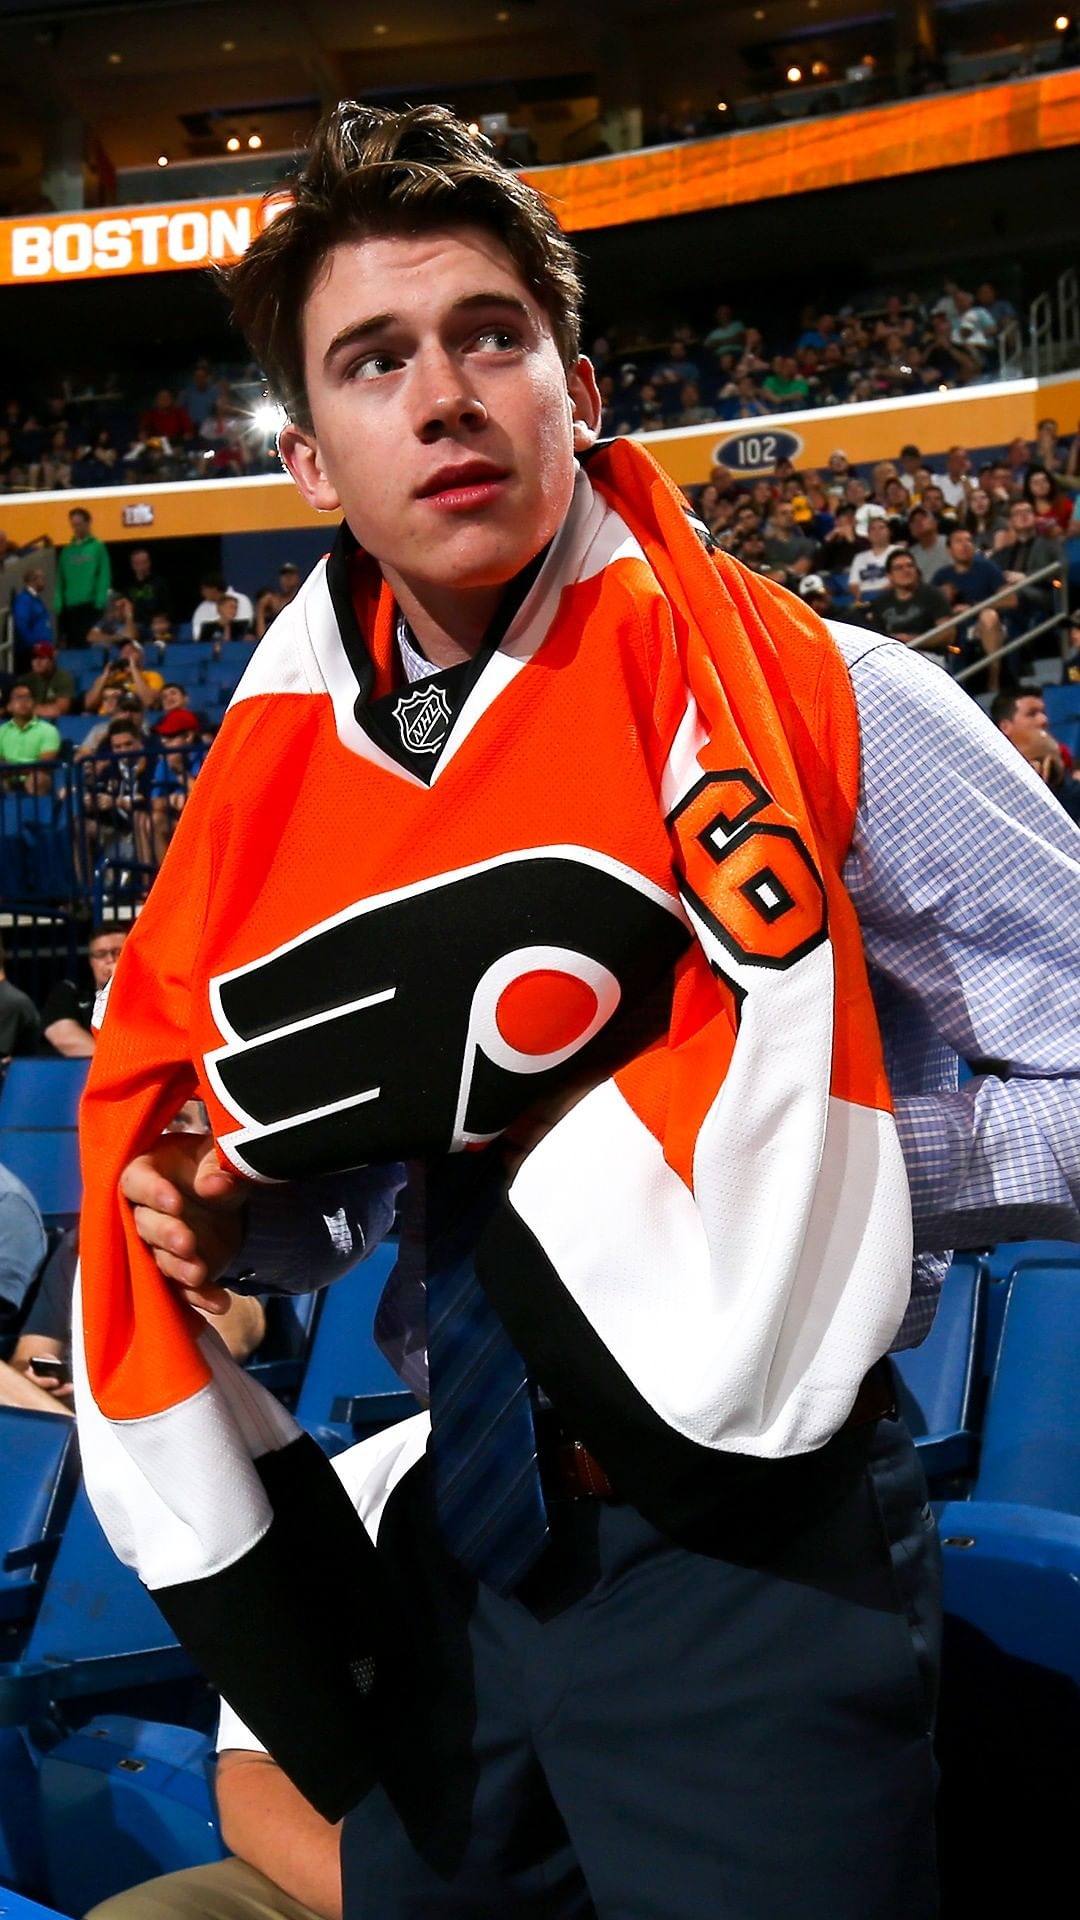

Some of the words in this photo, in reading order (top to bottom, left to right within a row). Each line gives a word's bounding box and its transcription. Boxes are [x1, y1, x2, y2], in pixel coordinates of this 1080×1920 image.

[11, 206, 251, 277] BOSTON
[738, 436, 777, 465] 102
[412, 703, 440, 744] NHL
[664, 767, 829, 971] 6
